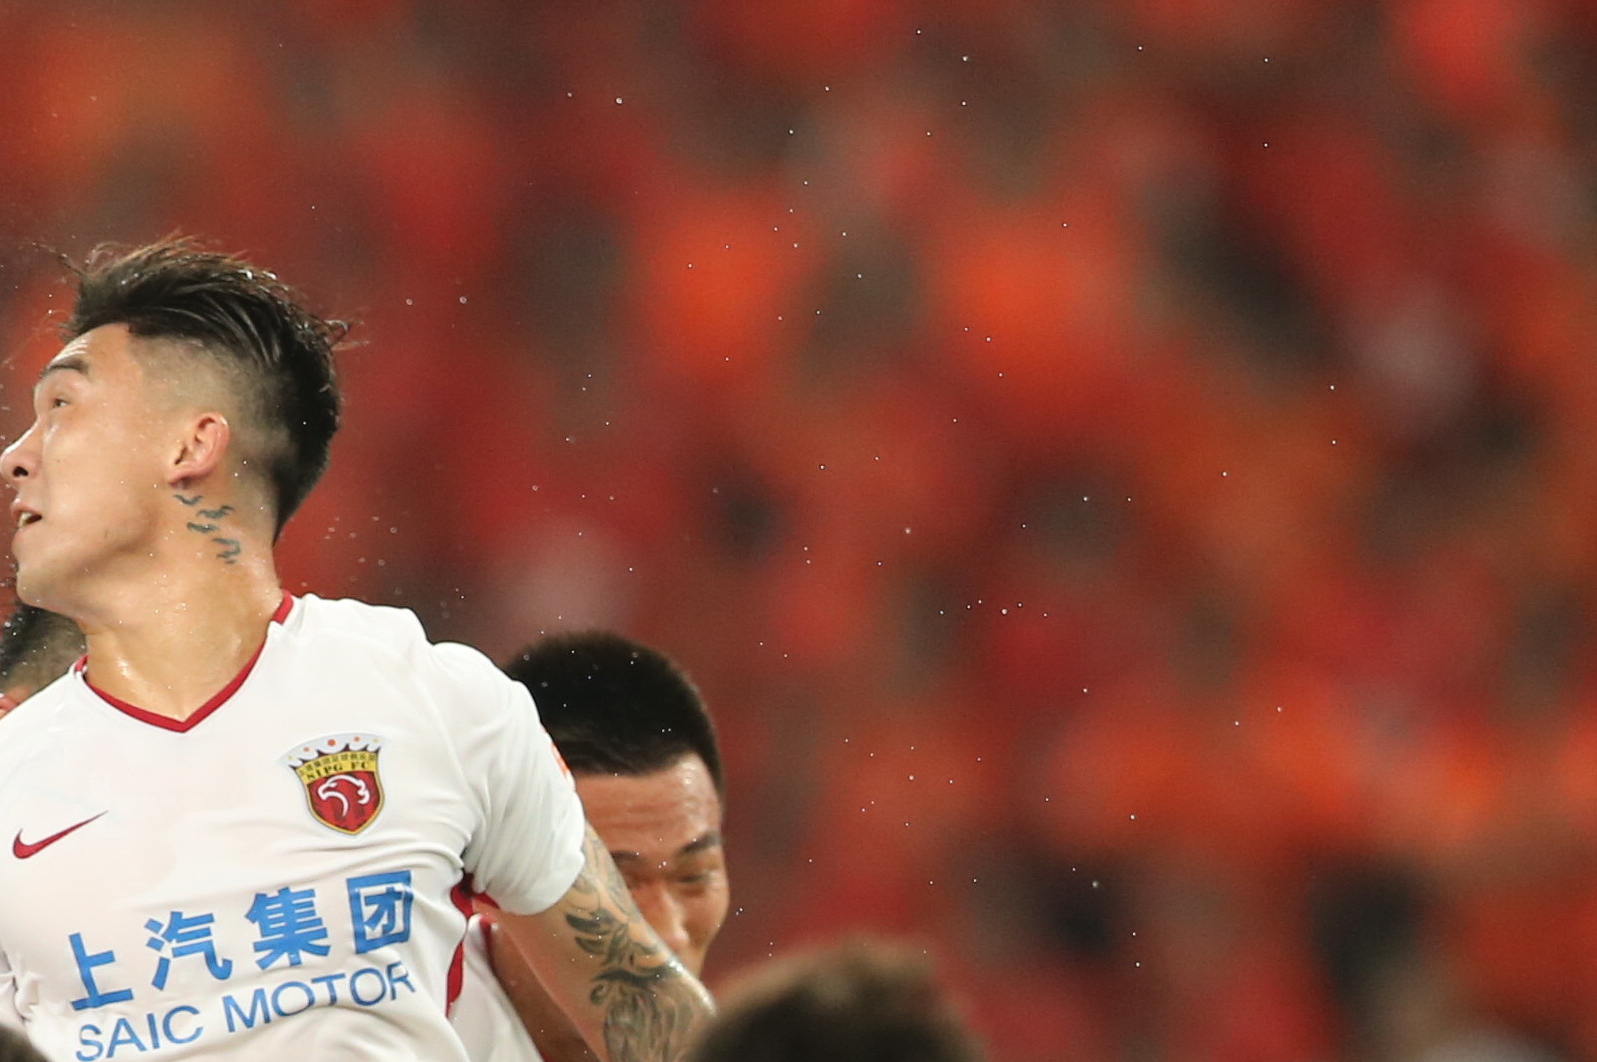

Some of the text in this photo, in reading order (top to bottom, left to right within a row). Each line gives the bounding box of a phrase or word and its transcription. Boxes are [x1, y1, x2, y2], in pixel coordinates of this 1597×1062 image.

[69, 869, 415, 1011] 上汽集团
[75, 960, 417, 1062] SAIC MOTOR
